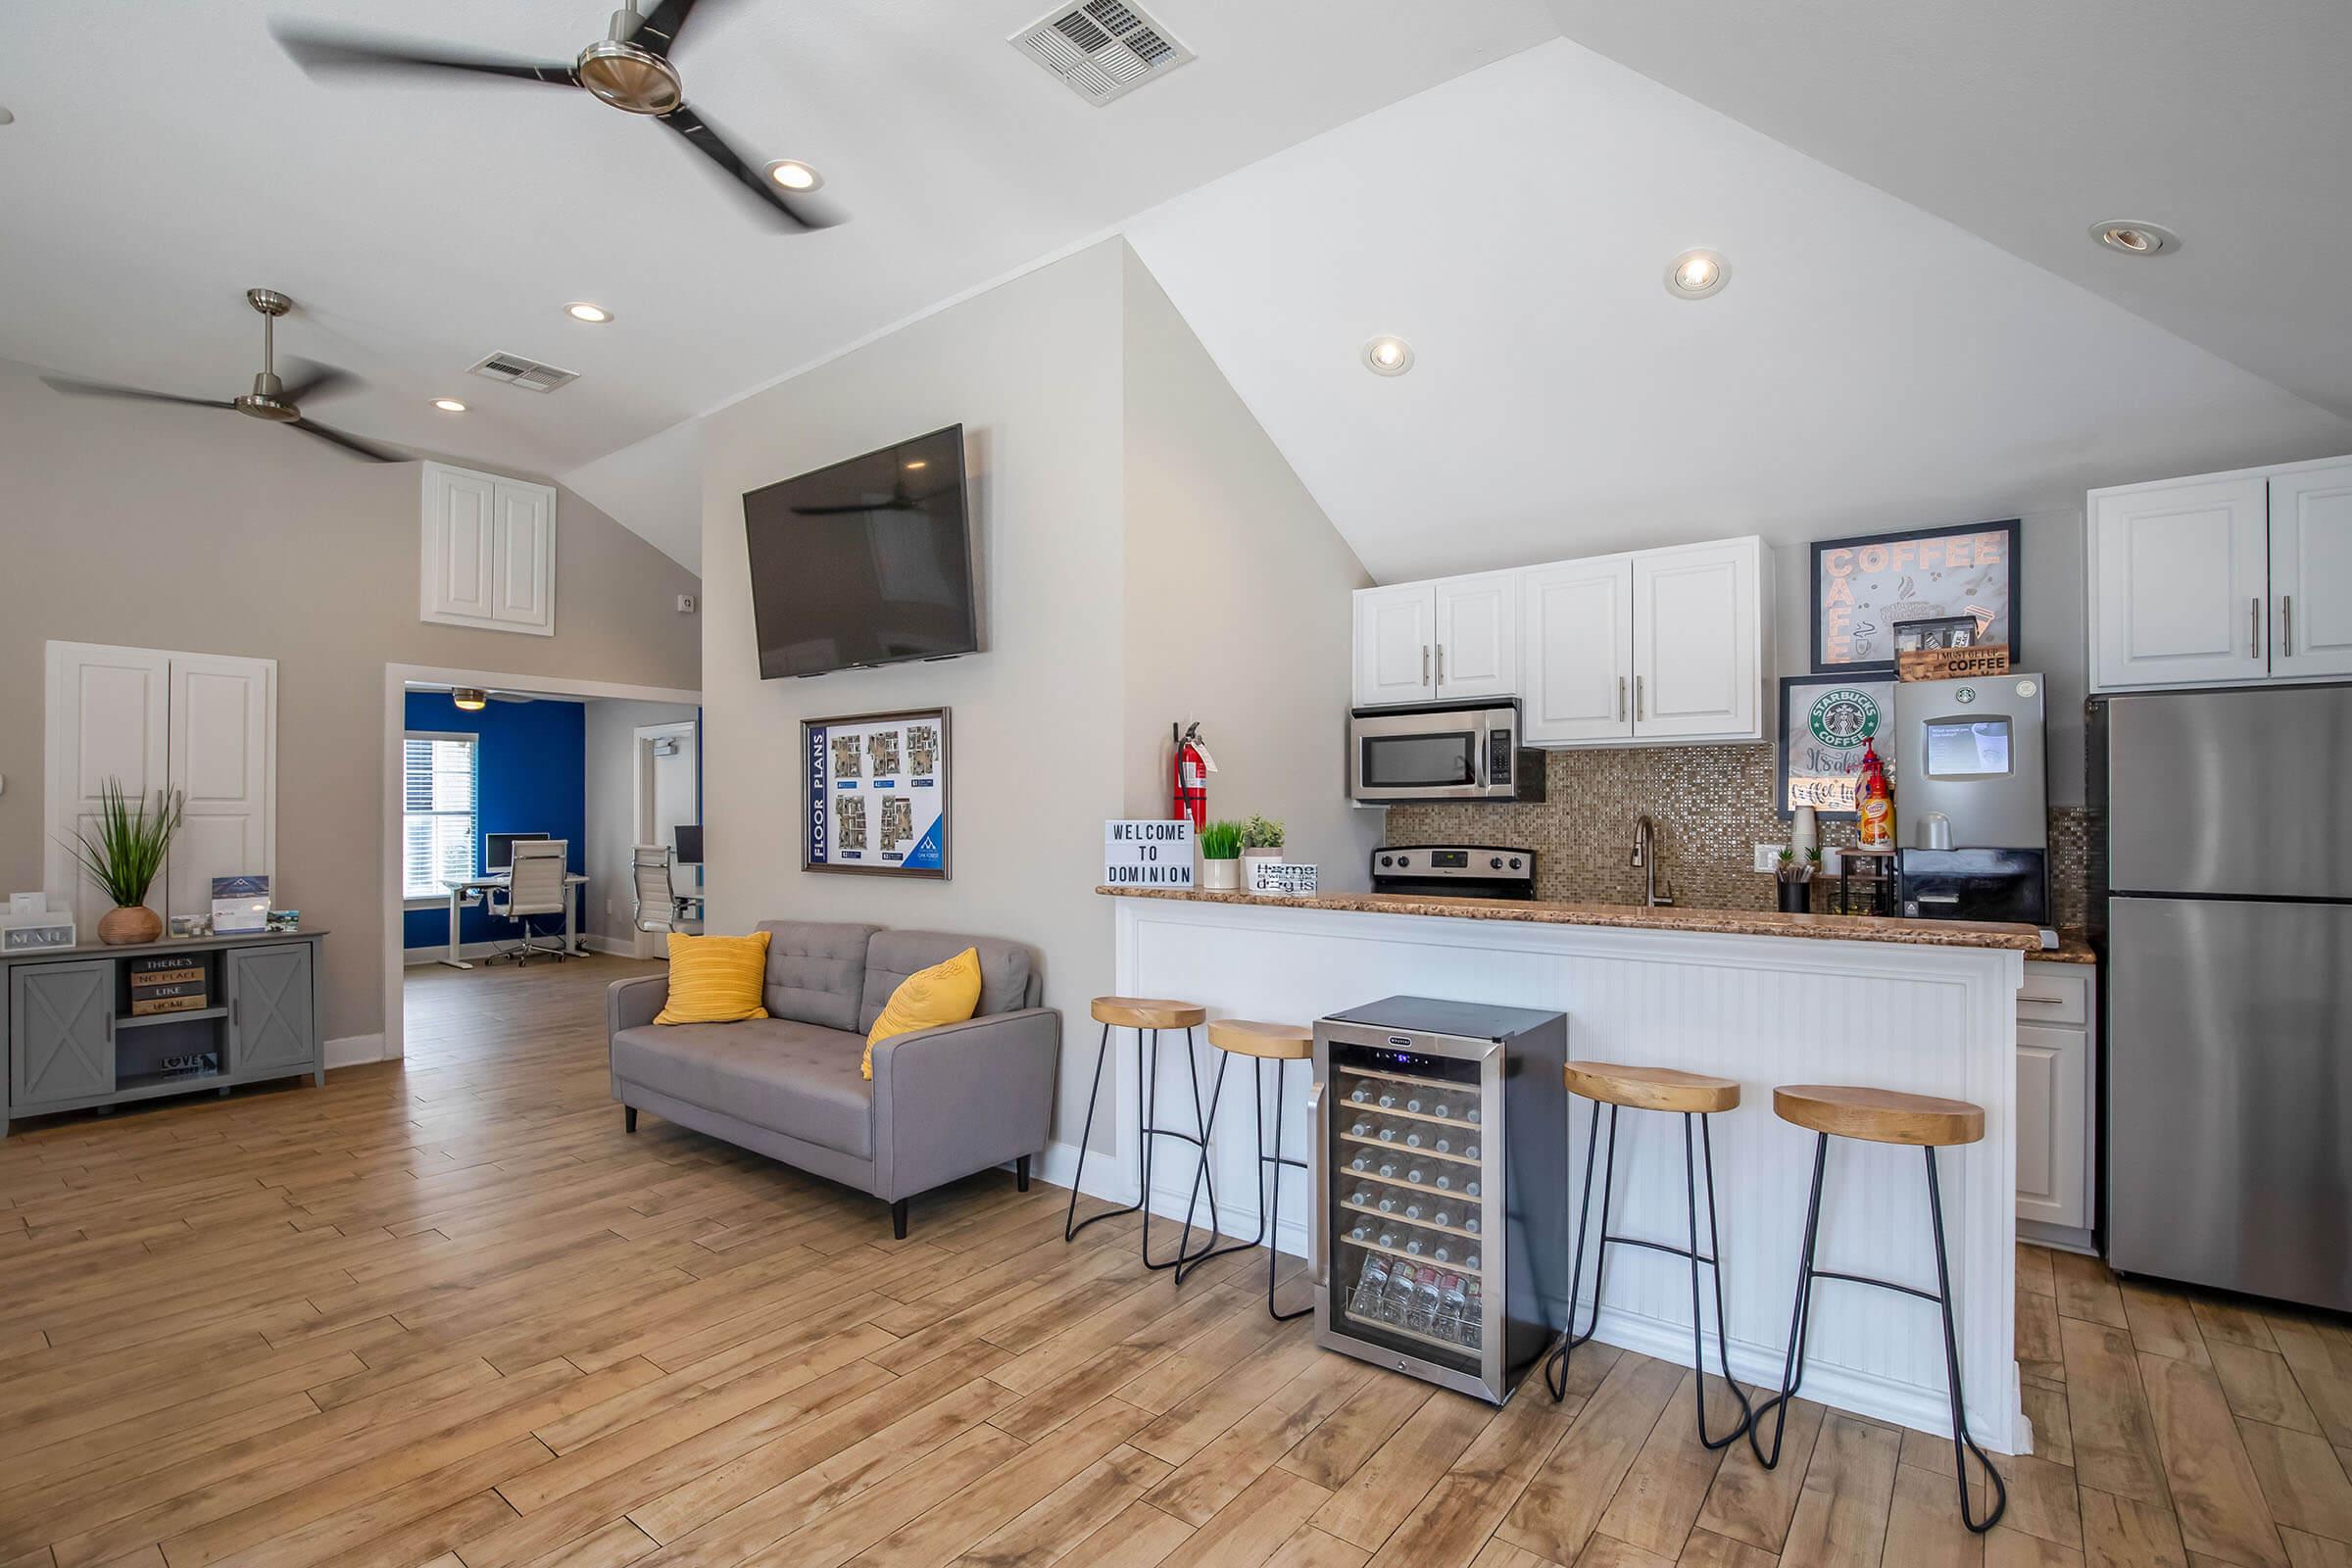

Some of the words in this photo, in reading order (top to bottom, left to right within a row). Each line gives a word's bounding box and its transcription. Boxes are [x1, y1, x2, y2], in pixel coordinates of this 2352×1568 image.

[1825, 535, 2001, 578] COFFEE
[1942, 651, 1966, 660] MUST
[1968, 649, 1984, 660] GET
[1948, 658, 2005, 671] COFFEE
[1812, 691, 1877, 716] STARBUCKS
[1818, 731, 1867, 746] COFFEE
[814, 734, 824, 789] PLANS
[814, 800, 824, 858] FLOOR
[1113, 824, 1185, 840] WELCOME
[1139, 846, 1157, 861] TO
[1108, 866, 1191, 883] DOMINION
[12, 932, 67, 944] MAIL
[147, 958, 193, 969] THERE'S
[162, 971, 197, 981] PLACE
[156, 986, 181, 996] LIKE
[153, 1001, 183, 1010] HOME
[162, 1054, 198, 1069] LOVE
